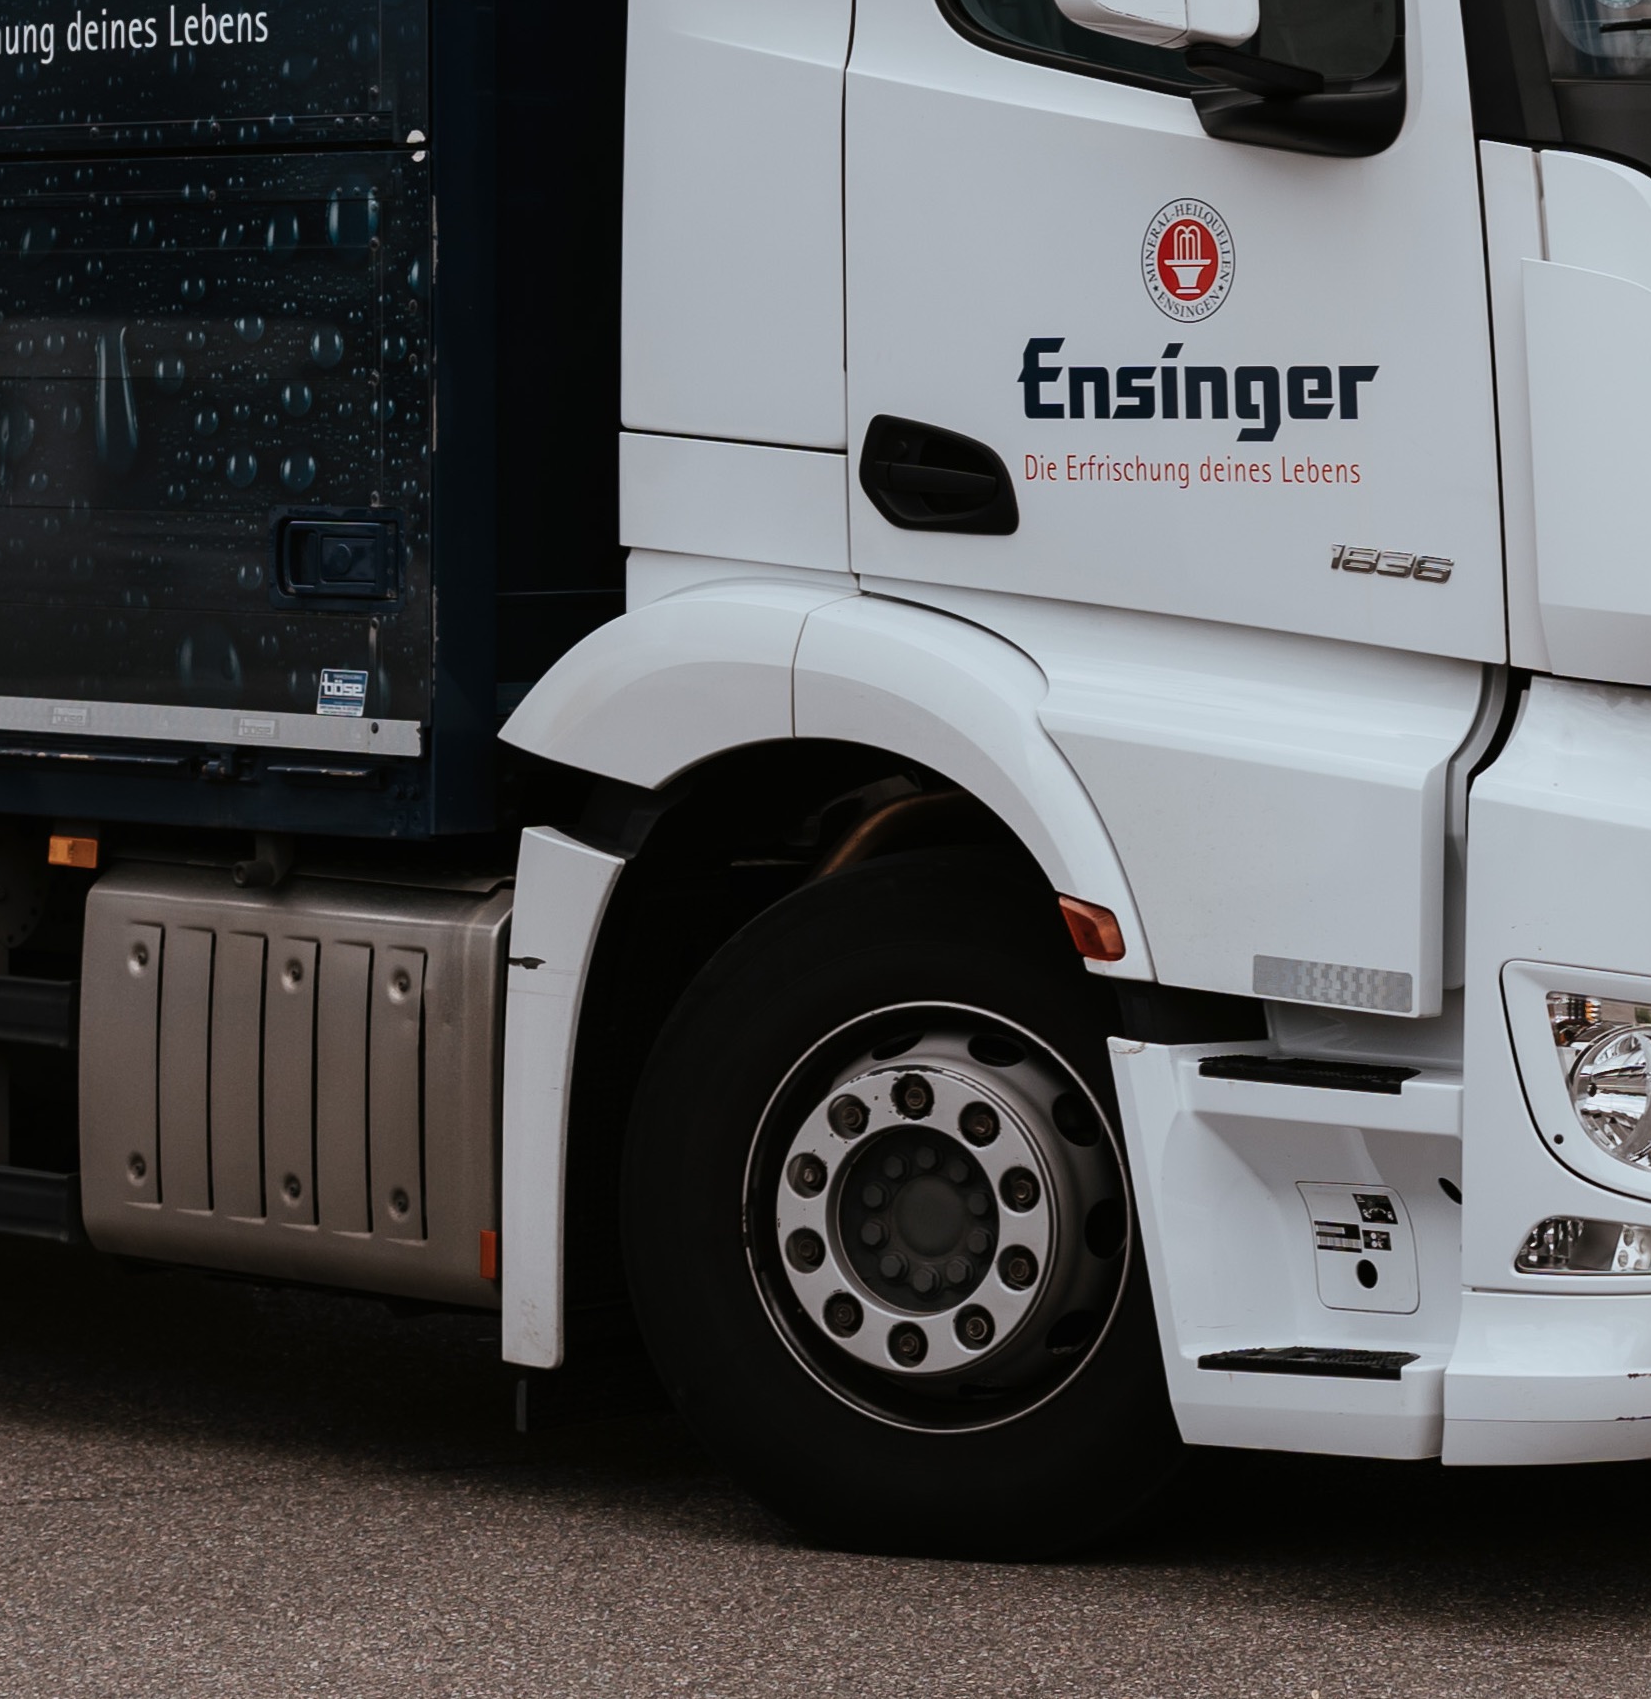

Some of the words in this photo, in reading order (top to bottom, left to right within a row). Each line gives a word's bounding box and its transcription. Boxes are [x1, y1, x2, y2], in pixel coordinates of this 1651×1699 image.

[66, 8, 157, 51] deines
[169, 3, 269, 47] Lebens
[1145, 203, 1233, 284] MINERAL-HEILQUELLEN
[1157, 290, 1222, 318] ENSINGEN
[1017, 337, 1380, 442] Ensinger
[1024, 454, 1057, 481] Die
[1066, 454, 1189, 489] Erfrischung
[1199, 456, 1272, 483] deines
[1281, 456, 1361, 484] Lebens
[1331, 543, 1454, 584] 1836
